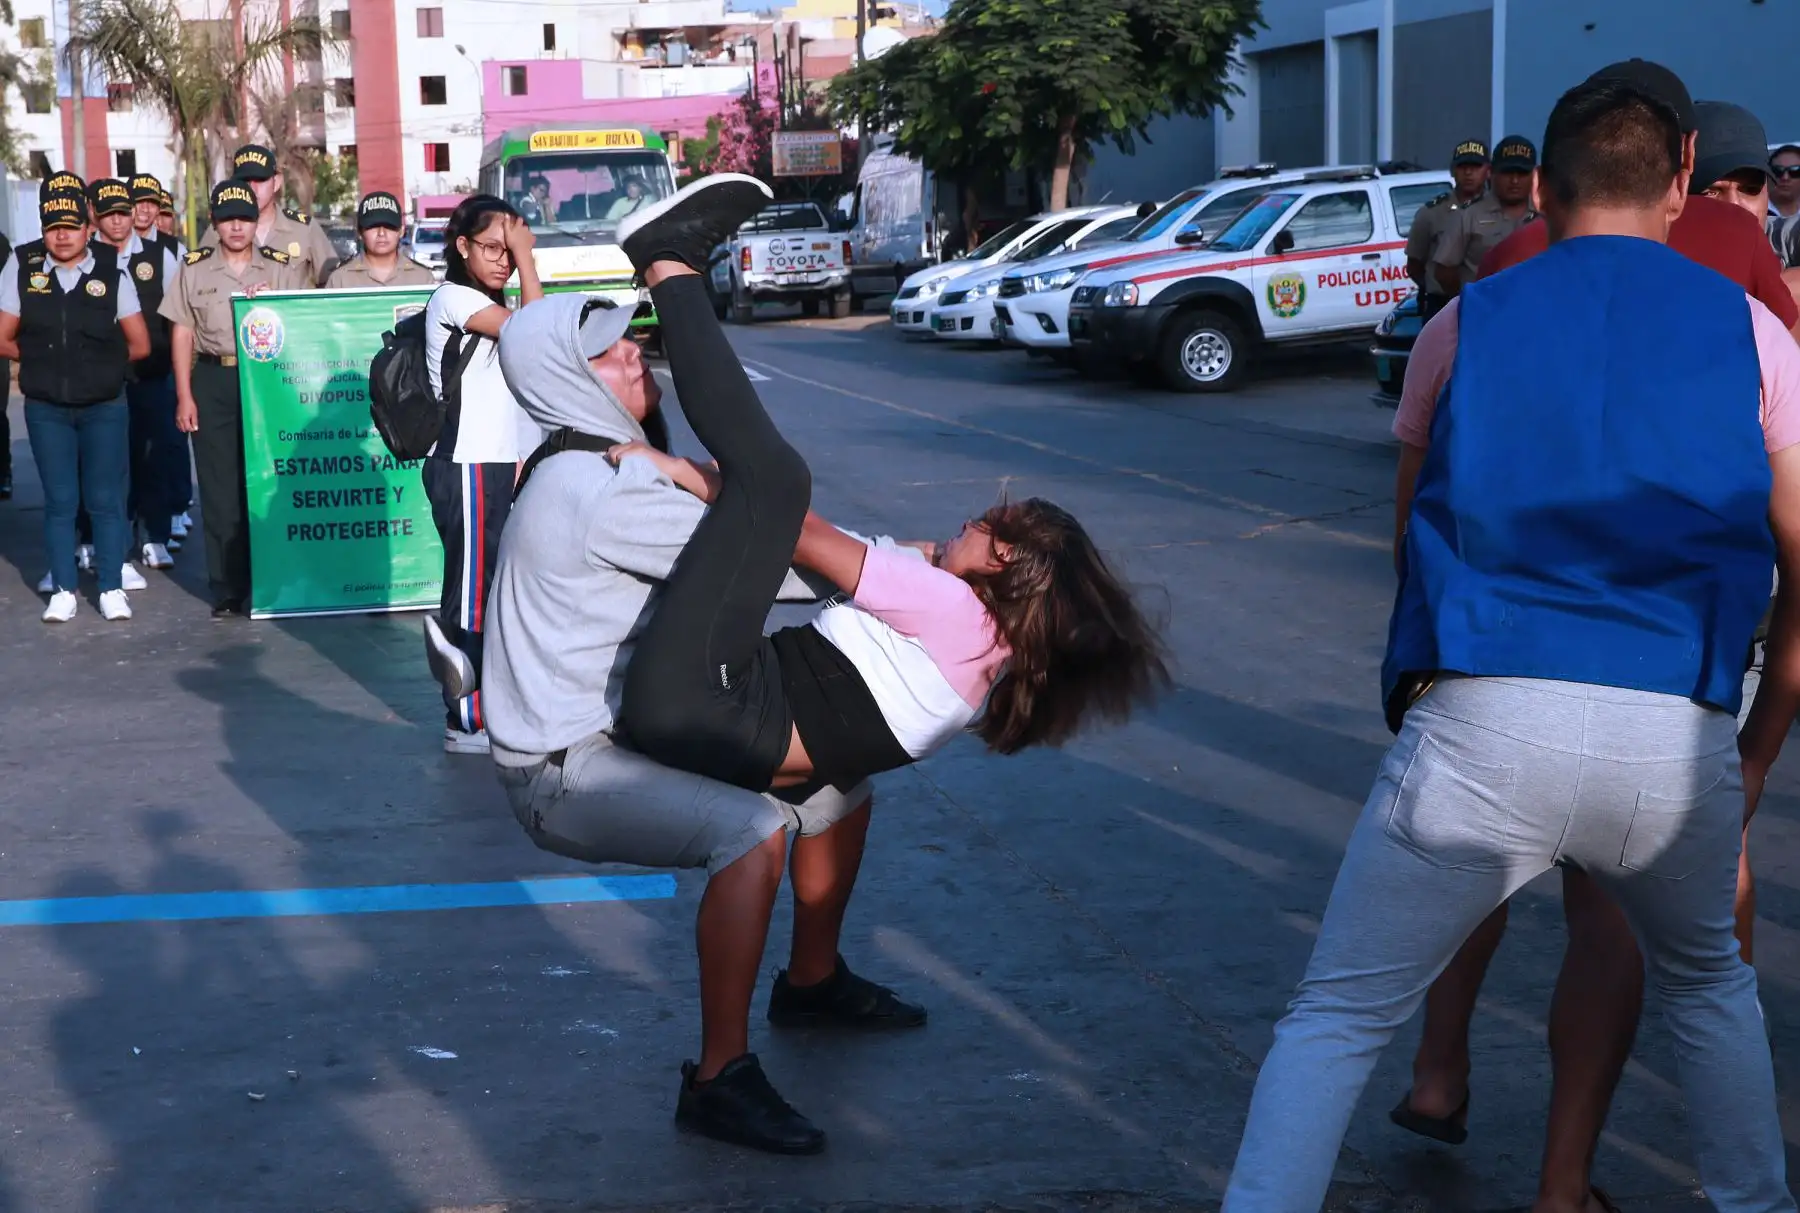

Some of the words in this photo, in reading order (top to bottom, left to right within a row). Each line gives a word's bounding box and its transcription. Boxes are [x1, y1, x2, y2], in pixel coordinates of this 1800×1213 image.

[1456, 142, 1485, 156] POLICIA
[235, 151, 267, 167] POLICIA
[48, 175, 82, 192] POLICIA
[133, 177, 160, 193] POLICIA
[98, 185, 130, 200] POLICIA
[217, 186, 253, 205] POLICIA
[43, 199, 79, 215] POLICIA
[362, 196, 399, 214] POLICIA
[767, 255, 826, 268] TOYOTA
[1317, 268, 1377, 288] POLICIA
[1355, 286, 1415, 307] UDE
[299, 389, 365, 405] DIVOPUS
[278, 428, 334, 441] Comisaria
[338, 427, 351, 439] de
[355, 426, 368, 438] La
[273, 455, 364, 476] ESTAMOS
[292, 487, 387, 509] SERVIRTE
[392, 486, 404, 503] Y
[287, 518, 413, 541] PROTEGERTE
